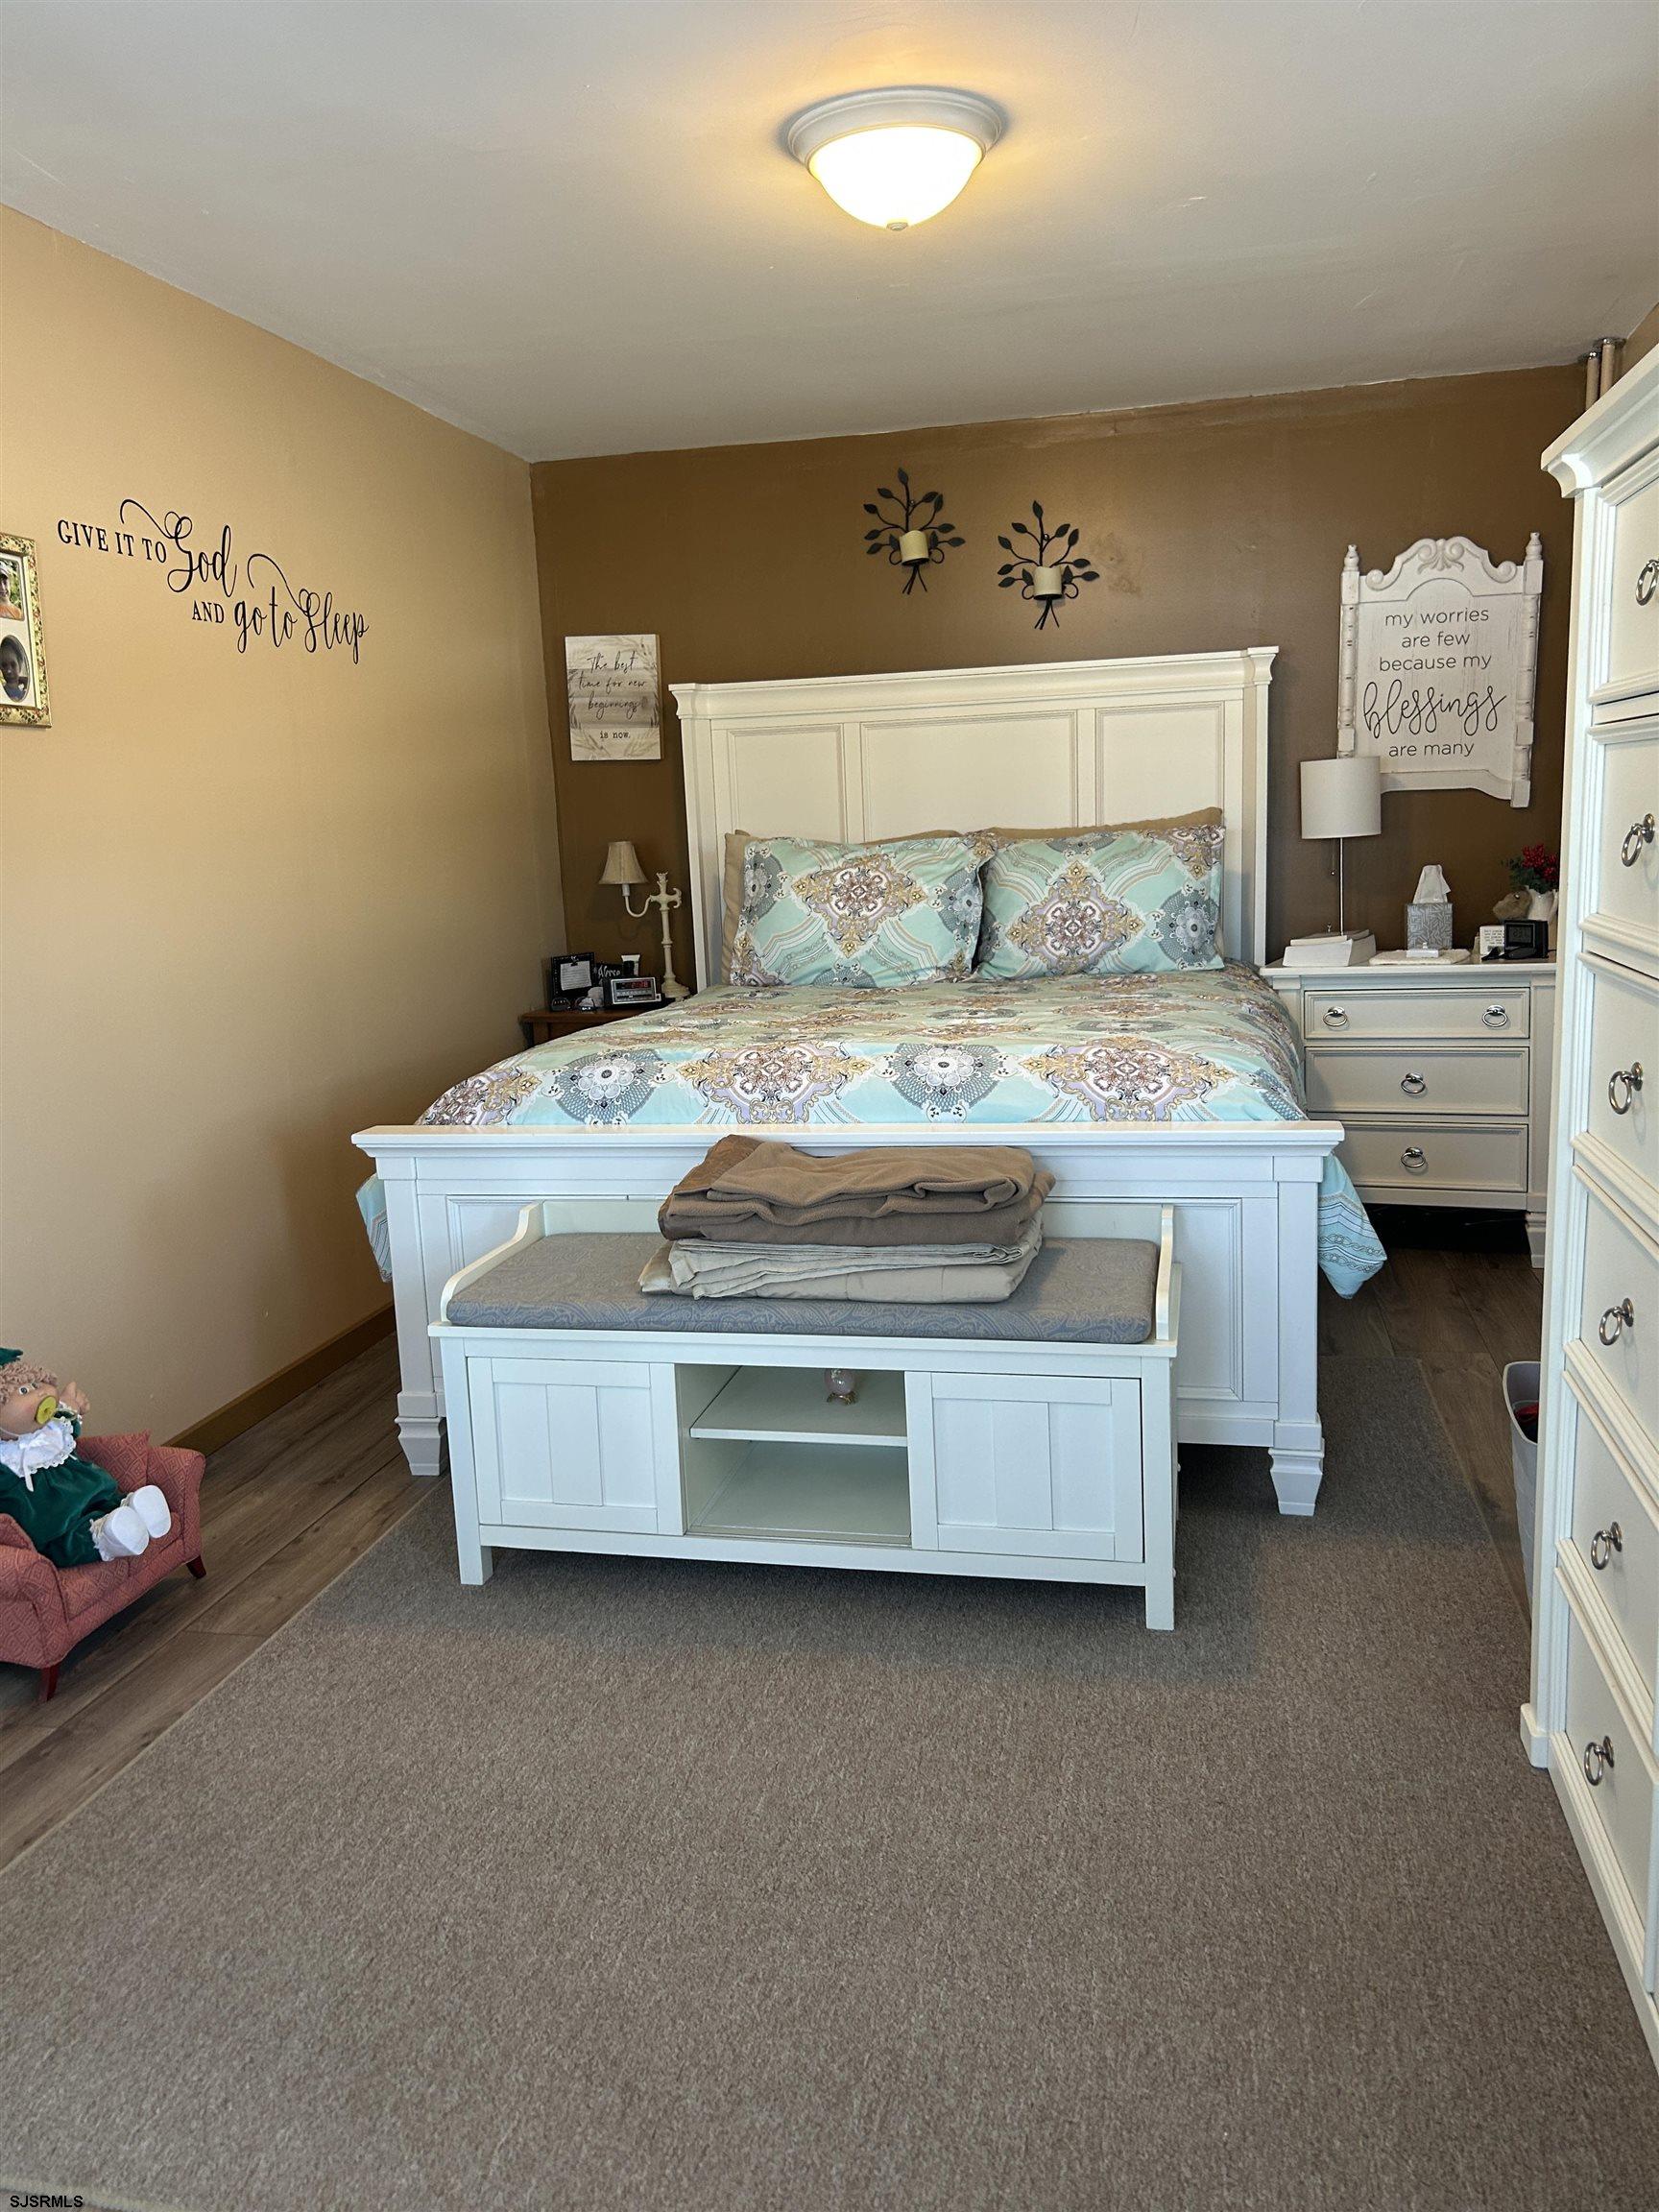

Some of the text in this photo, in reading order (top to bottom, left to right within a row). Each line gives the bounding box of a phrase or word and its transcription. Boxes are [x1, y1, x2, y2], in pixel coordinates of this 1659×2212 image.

[57, 498, 237, 597] GIVE IT TO God
[191, 600, 226, 624] AND
[234, 600, 267, 653] go
[269, 586, 298, 648] to
[1384, 607, 1489, 628] my worries
[1401, 631, 1470, 648] are few
[587, 651, 639, 674] The best
[1379, 655, 1492, 671] because my
[578, 671, 646, 694] time for new
[1362, 679, 1507, 738] blessings
[600, 731, 609, 739] is
[1388, 742, 1475, 757] are many
